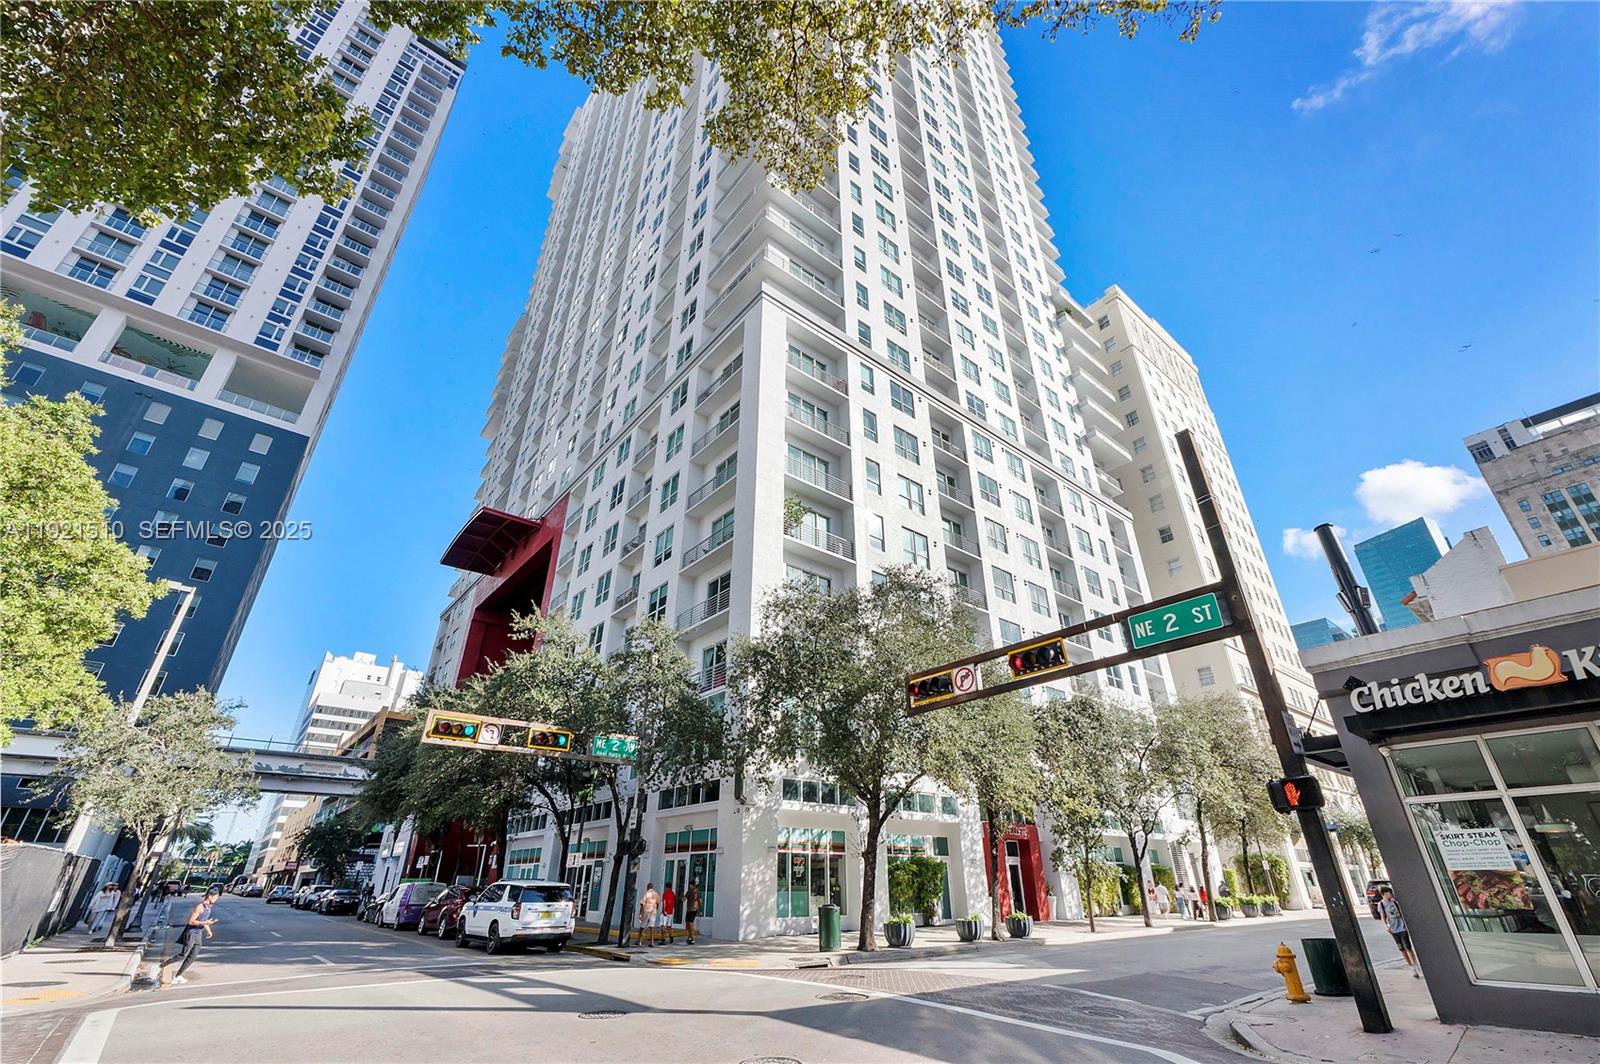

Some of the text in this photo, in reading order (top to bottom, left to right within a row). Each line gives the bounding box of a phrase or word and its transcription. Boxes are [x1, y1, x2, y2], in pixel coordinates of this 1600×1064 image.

[1135, 604, 1211, 638] NE 2 ST
[1350, 644, 1600, 713] Chicken K
[596, 739, 606, 749] NE
[612, 740, 620, 752] 2
[1467, 831, 1498, 839] STEAK
[1442, 838, 1501, 848] Chop-Chop
